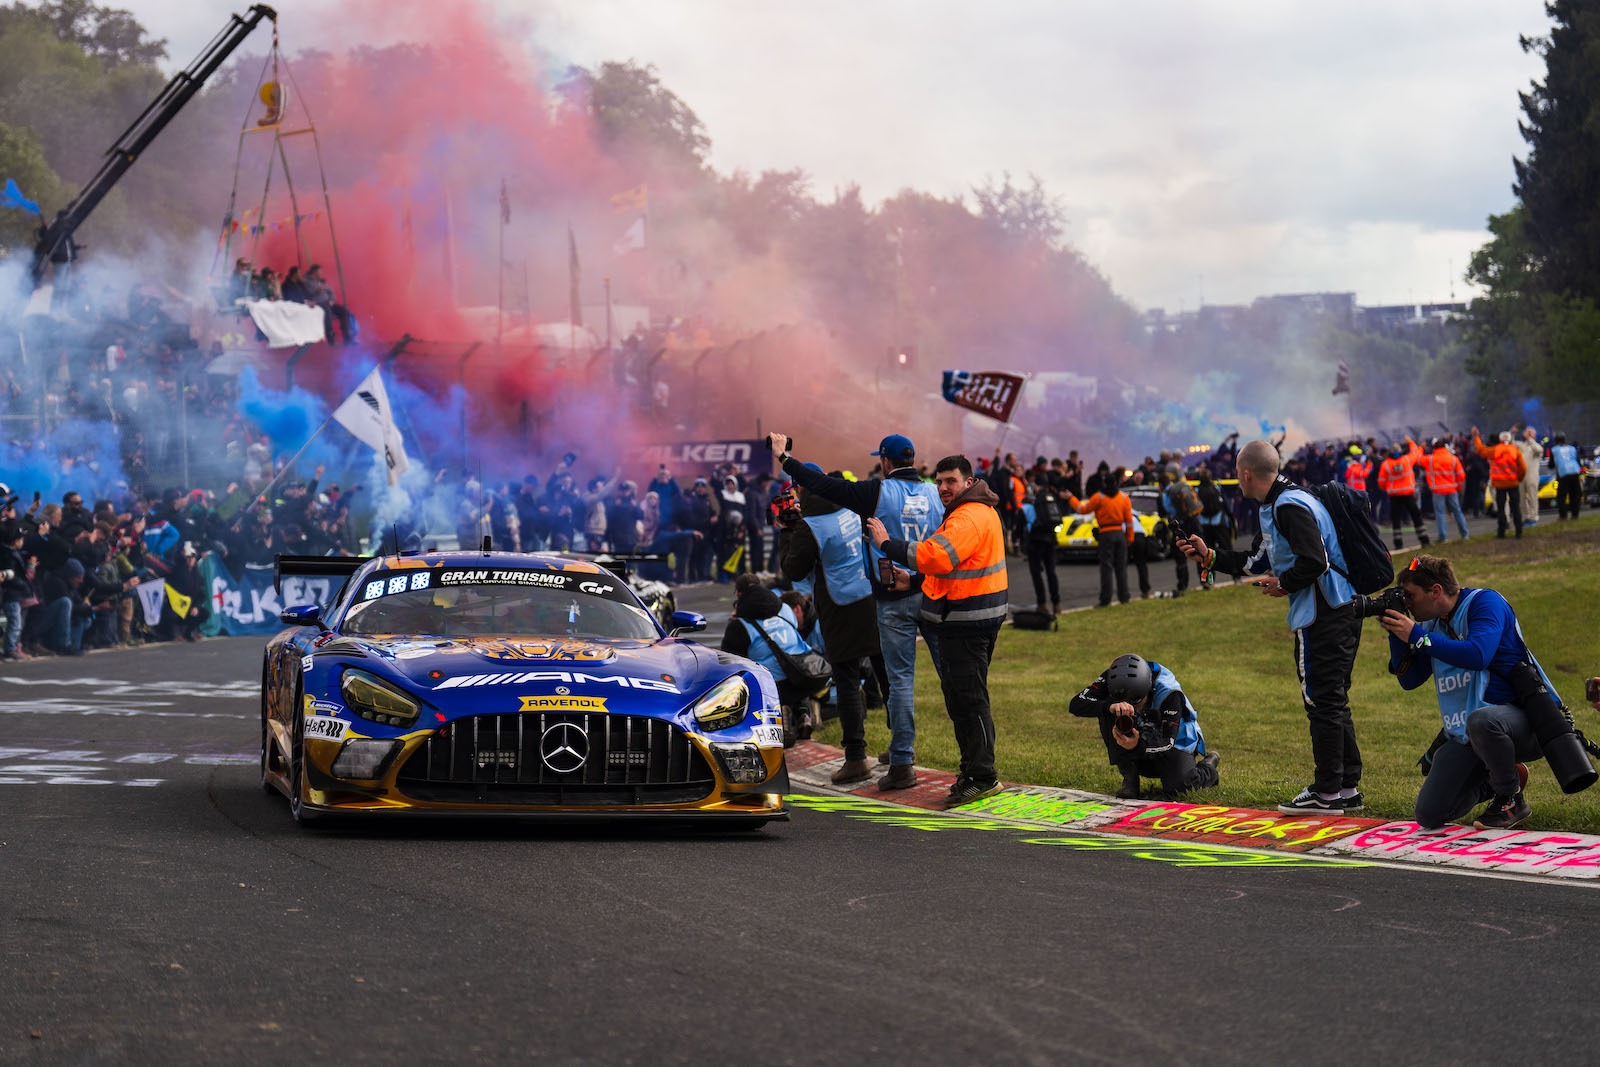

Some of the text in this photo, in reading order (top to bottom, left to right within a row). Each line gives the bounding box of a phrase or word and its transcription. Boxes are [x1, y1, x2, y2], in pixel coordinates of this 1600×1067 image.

[901, 523, 929, 542] TV
[441, 571, 488, 581] GRAN
[513, 672, 681, 694] AMG
[1437, 671, 1471, 693] EDIA
[528, 699, 600, 708] RAVENOL
[305, 719, 326, 734] H&R
